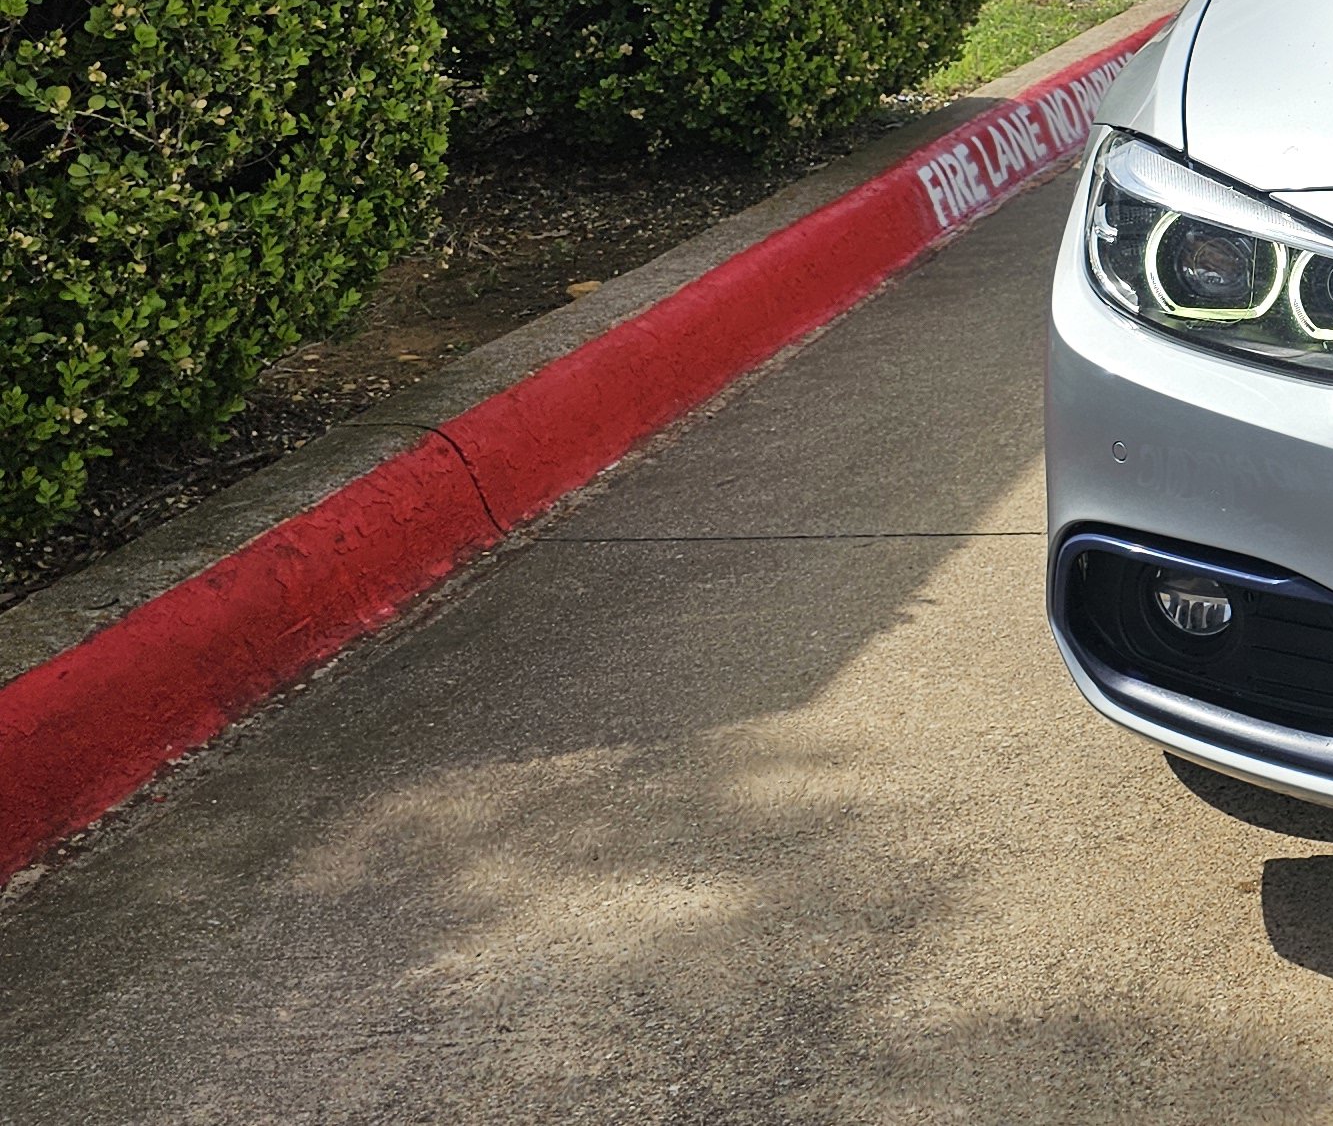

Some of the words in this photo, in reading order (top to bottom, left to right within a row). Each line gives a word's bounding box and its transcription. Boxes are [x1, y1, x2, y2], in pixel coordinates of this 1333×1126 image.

[917, 143, 988, 227] FIRE
[970, 104, 1047, 188] LANE
[1035, 88, 1084, 151] NO
